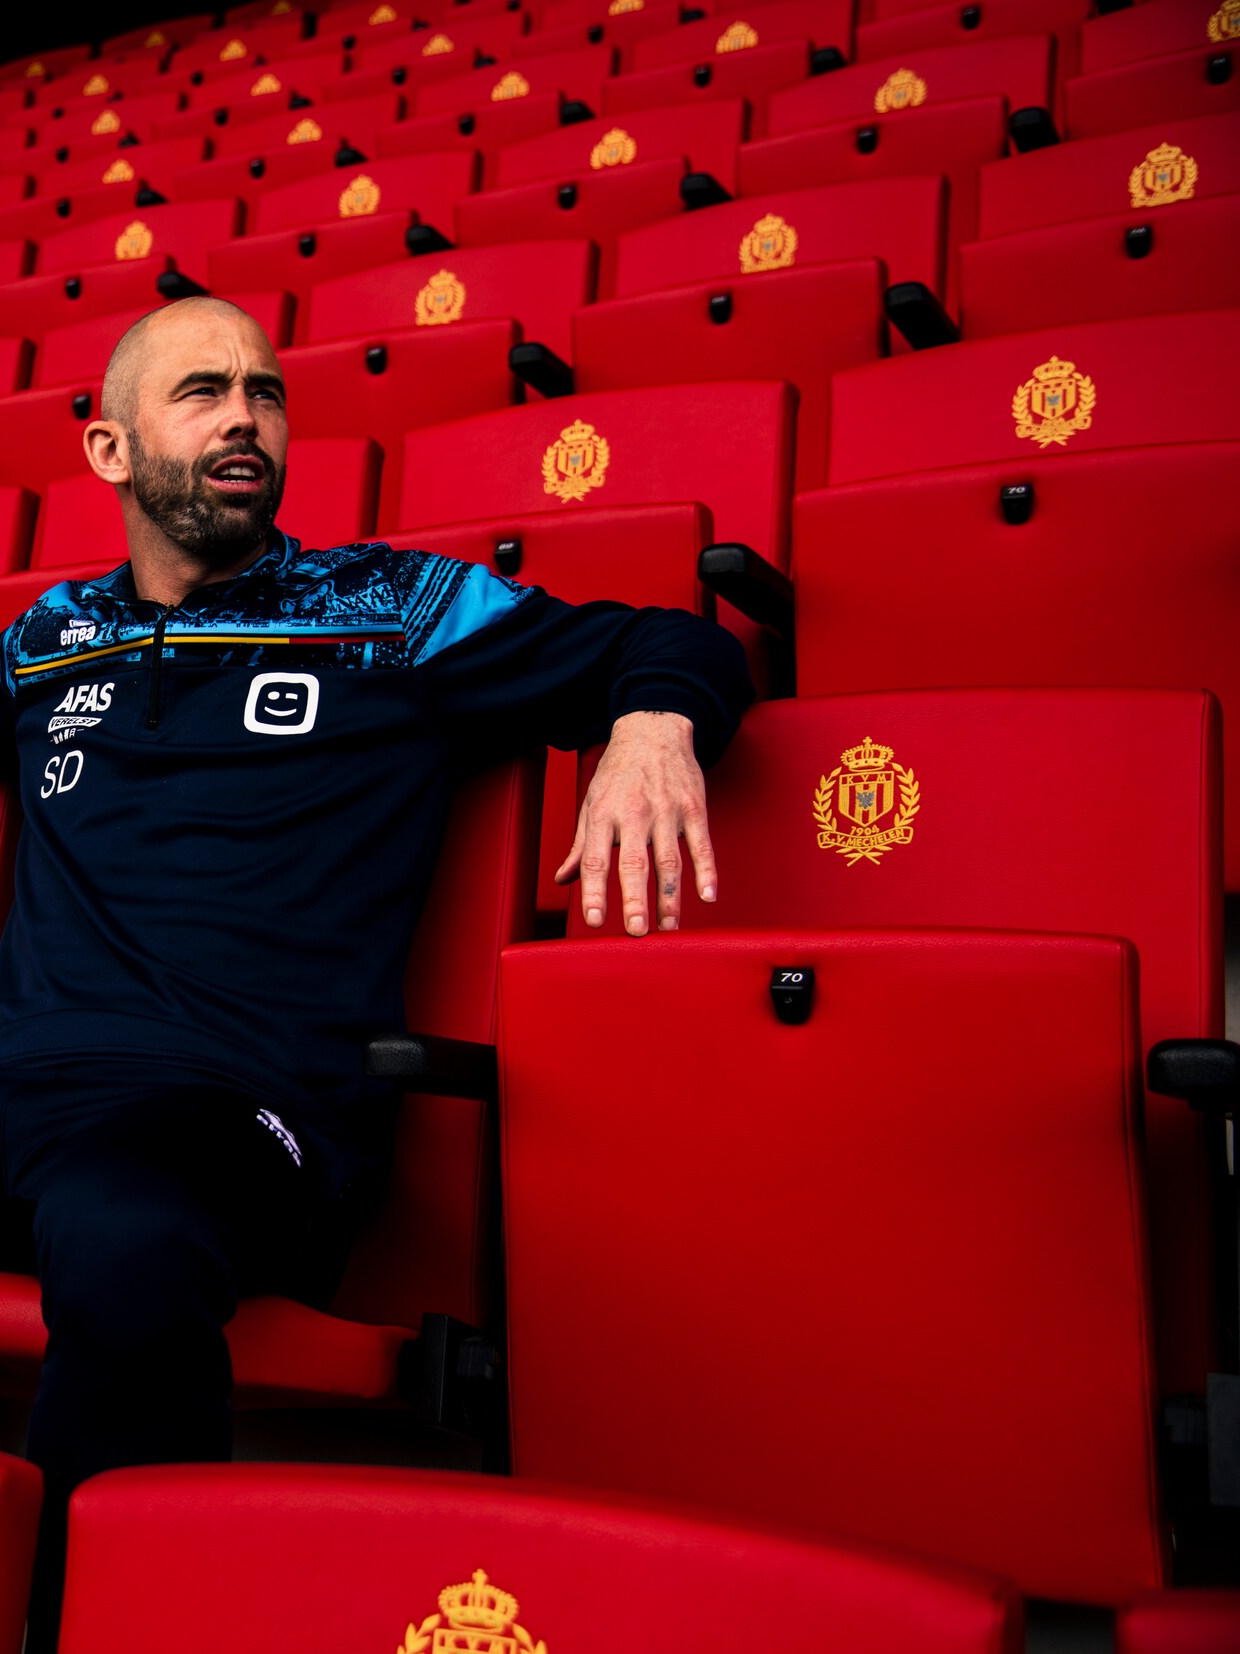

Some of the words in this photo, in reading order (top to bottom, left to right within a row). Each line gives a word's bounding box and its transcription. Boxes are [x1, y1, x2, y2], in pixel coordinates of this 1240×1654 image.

[1008, 486, 1026, 494] 70
[53, 682, 115, 713] AFAS
[50, 717, 98, 728] VERELST
[40, 749, 84, 799] SD
[850, 824, 880, 836] 1904
[780, 973, 803, 983] 70
